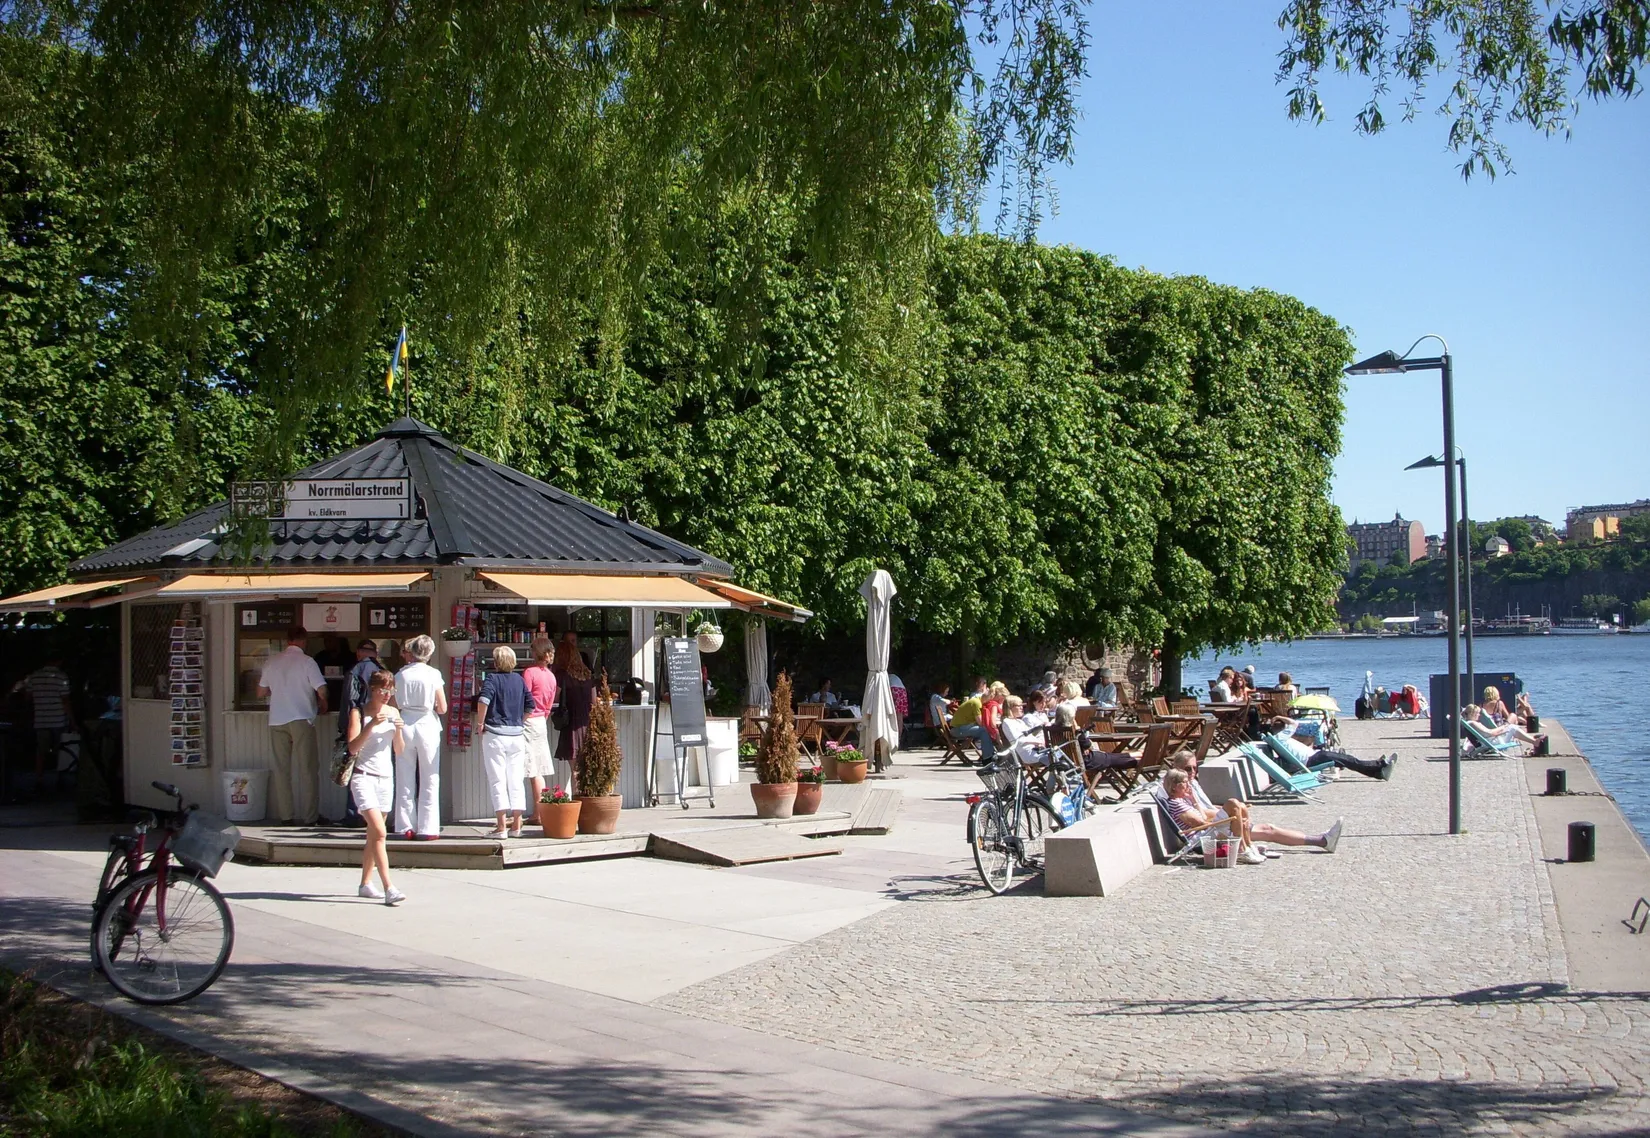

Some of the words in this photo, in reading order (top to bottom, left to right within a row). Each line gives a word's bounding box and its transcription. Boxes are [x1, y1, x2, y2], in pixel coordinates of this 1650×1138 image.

[308, 481, 403, 497] Norrmälarstrand
[308, 508, 318, 516] kv.
[319, 508, 347, 516] Eldkvarn
[398, 503, 403, 517] 1
